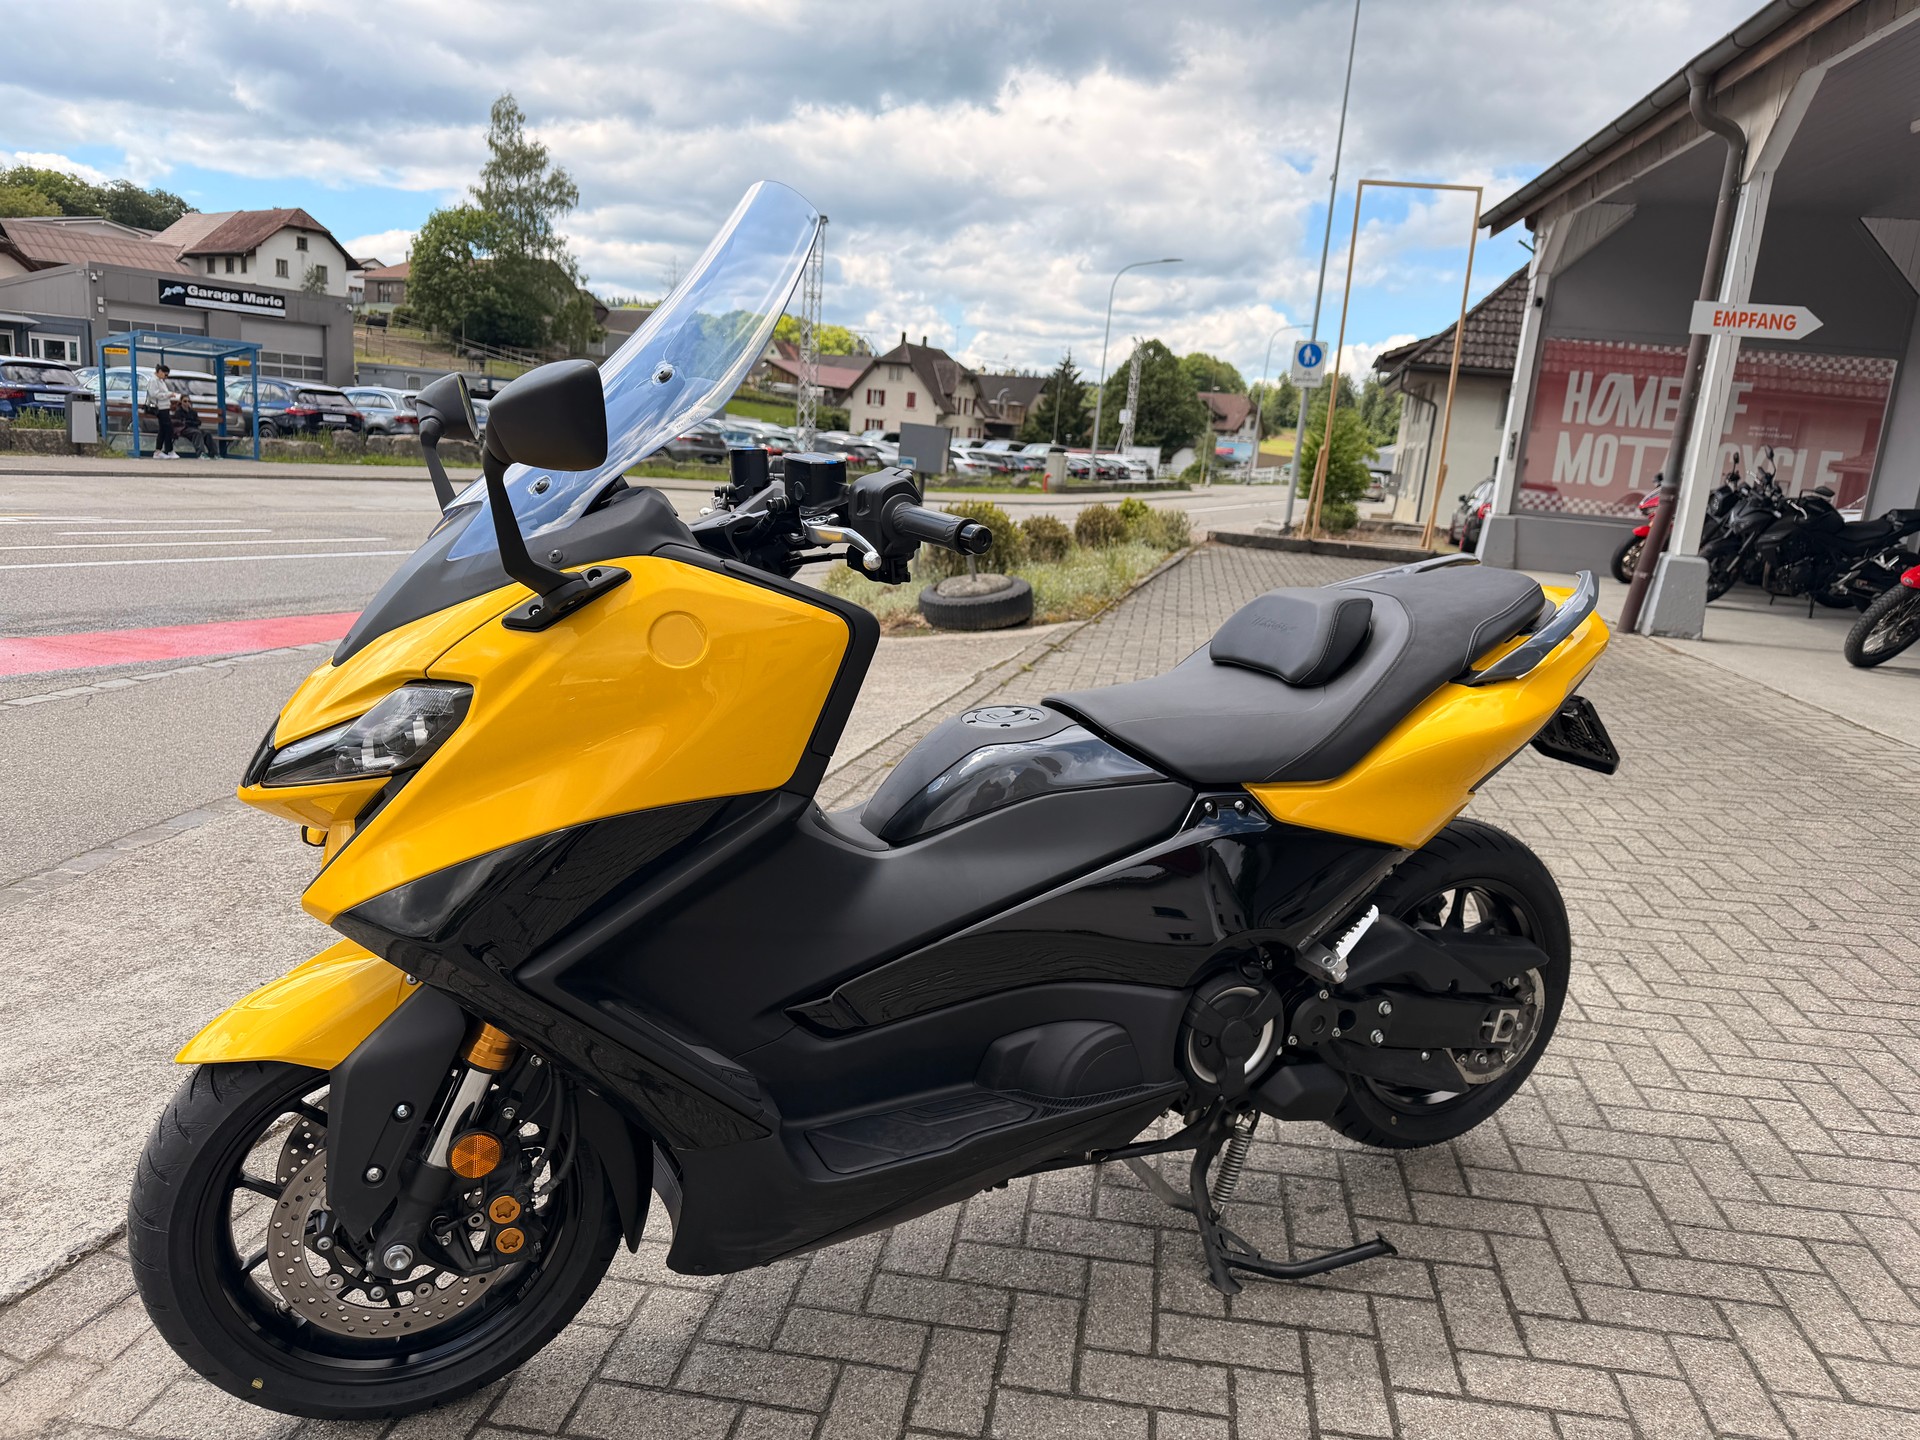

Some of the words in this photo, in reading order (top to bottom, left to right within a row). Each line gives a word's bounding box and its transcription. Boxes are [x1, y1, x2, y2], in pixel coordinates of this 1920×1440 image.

[187, 285, 240, 302] Garage
[242, 292, 283, 307] Mario
[1713, 310, 1797, 331] EMPFANG
[1552, 431, 1844, 506] MOTCYCLE
